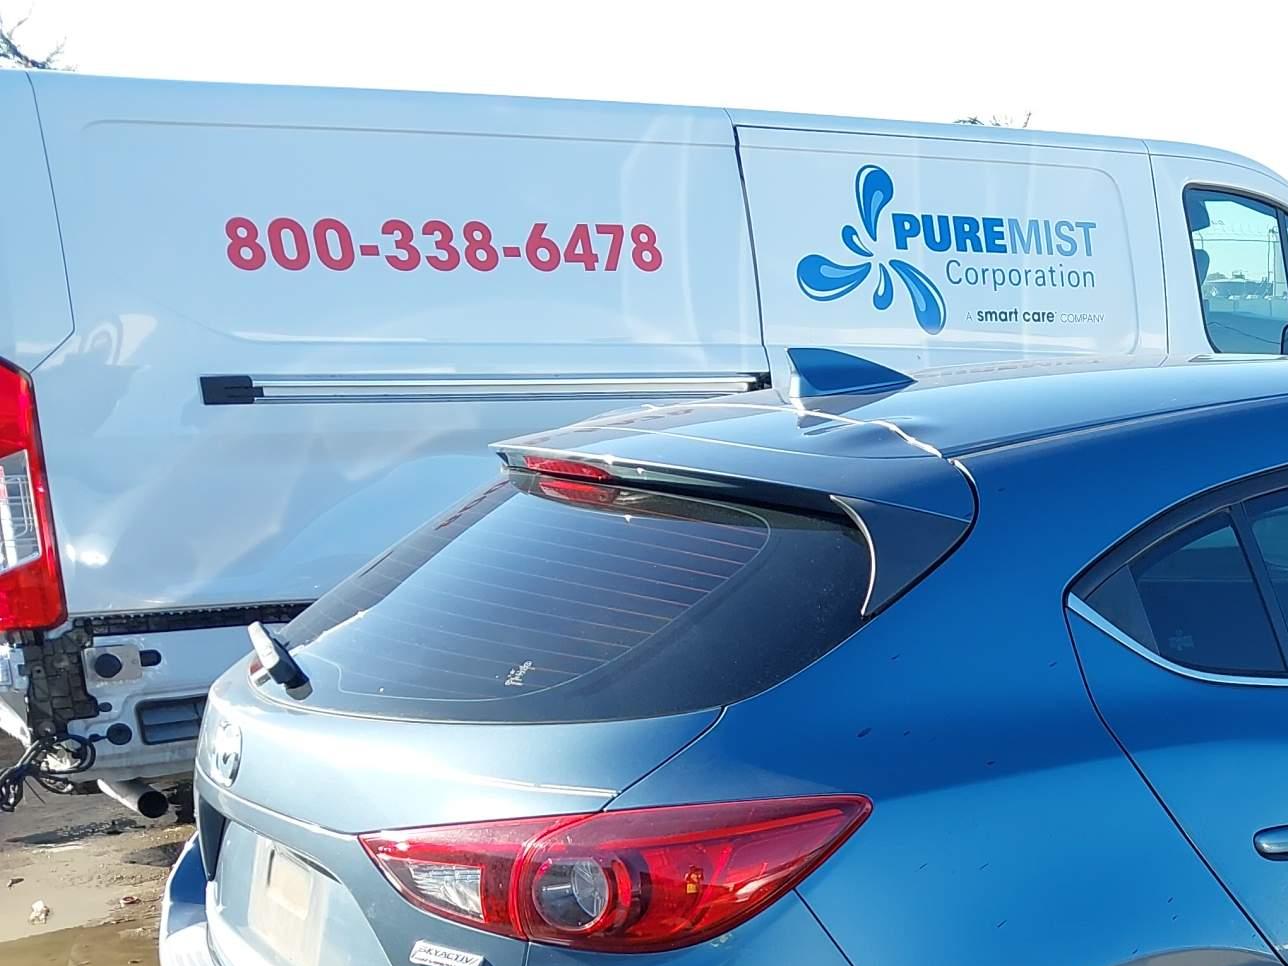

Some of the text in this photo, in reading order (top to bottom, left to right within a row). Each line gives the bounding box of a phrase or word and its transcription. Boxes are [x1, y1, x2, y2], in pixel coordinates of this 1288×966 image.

[225, 217, 664, 273] 800-338-6478
[892, 213, 1096, 256] PUREMIST
[946, 260, 1095, 291] Corporation
[966, 308, 1105, 323] A smart care COMPANY
[417, 945, 473, 964] SKYACTIV
